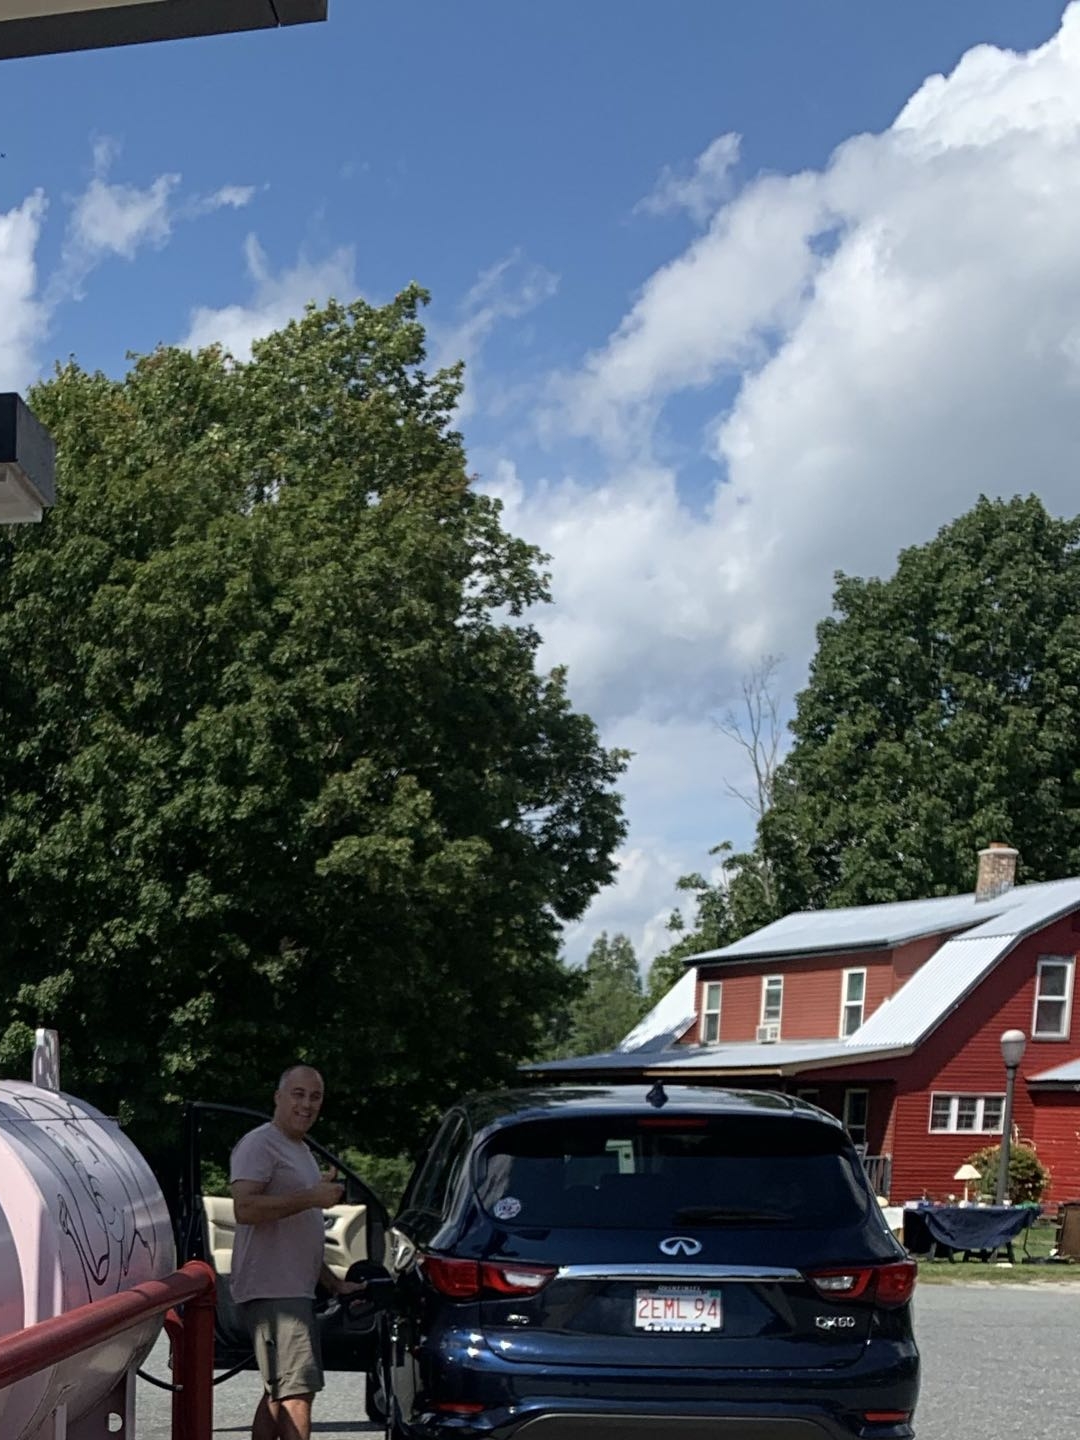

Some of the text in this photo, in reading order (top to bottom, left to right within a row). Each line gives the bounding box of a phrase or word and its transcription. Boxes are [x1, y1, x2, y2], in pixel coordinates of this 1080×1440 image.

[638, 1297, 718, 1319] 2EML 94
[815, 1316, 856, 1330] QX60
